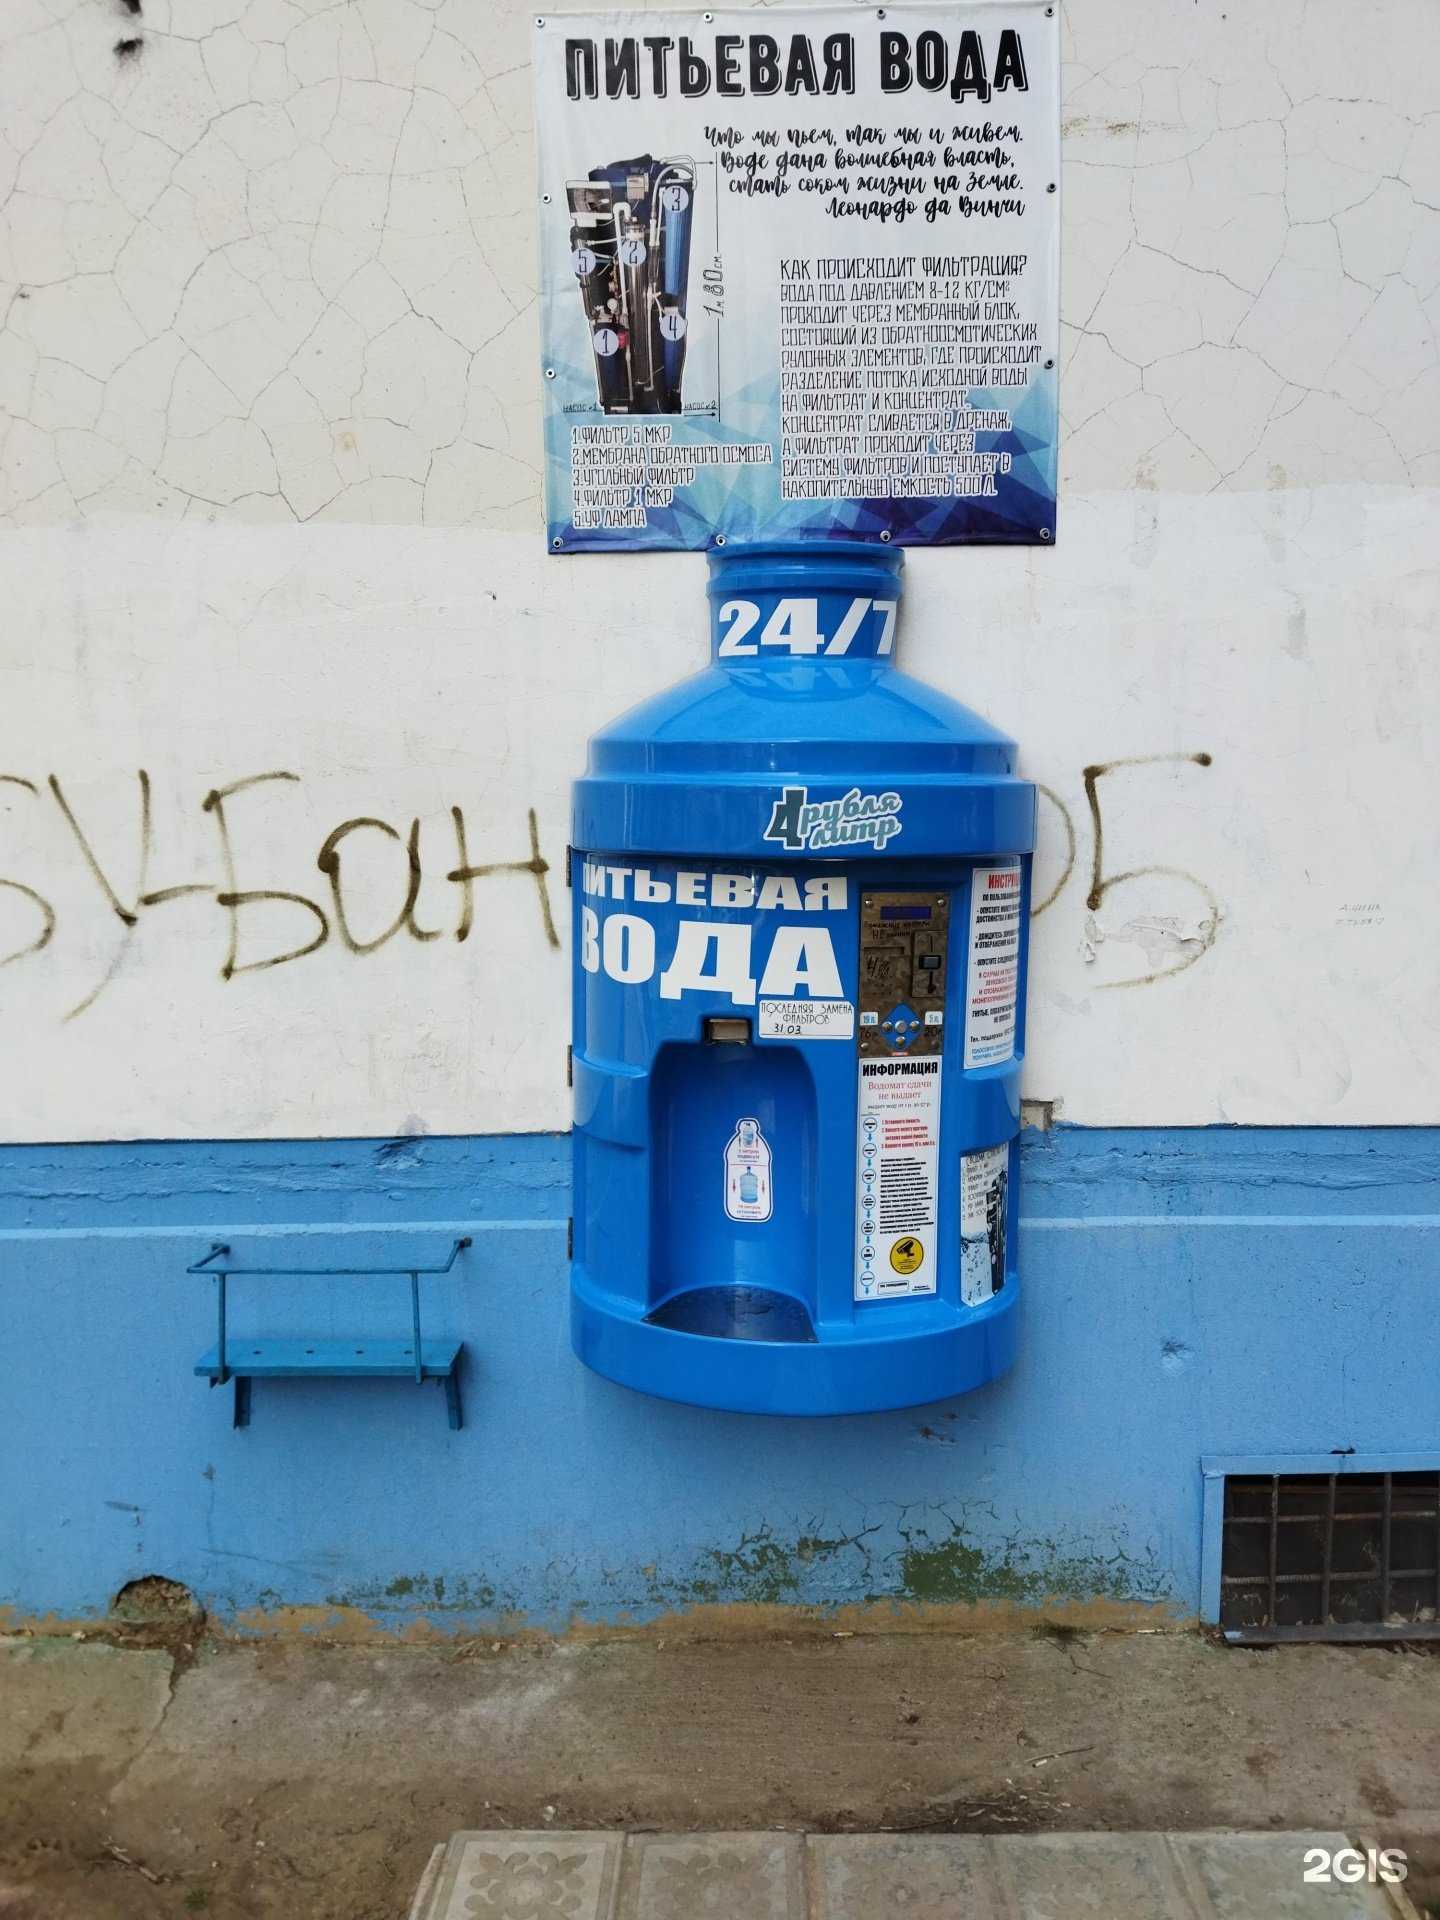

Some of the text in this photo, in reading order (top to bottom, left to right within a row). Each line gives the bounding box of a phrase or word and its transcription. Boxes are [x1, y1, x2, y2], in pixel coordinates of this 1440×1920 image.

[565, 29, 1029, 103] ПИТЬЕВАЯ ВОДА
[704, 125, 745, 148] Что
[752, 129, 780, 147] мы
[846, 125, 886, 145] так
[894, 127, 922, 145] мы
[929, 128, 944, 143] и
[952, 121, 1024, 143] живем.
[776, 151, 827, 176] дана
[834, 147, 937, 169] волшебная
[729, 175, 790, 197] стать
[798, 176, 850, 194] соком
[857, 174, 926, 197] жизни
[934, 174, 960, 193] на
[671, 187, 681, 212] 3
[924, 198, 951, 223] да
[578, 247, 587, 273] 5
[628, 240, 638, 265] 2
[781, 255, 1027, 280] КАК ПРОИСХОДИТ ФИЛЬТРАЦИЯ?
[781, 284, 814, 302] ВОДА
[819, 283, 846, 301] ПОД
[850, 281, 925, 302] ДАВЛЕНИЕМ
[930, 281, 959, 299] 8-12
[781, 300, 1020, 324] ПРОХОДИТ ЧЕРЕЗ МЕМБРАННЫЙ БЛОК,
[668, 317, 678, 339] 4
[781, 323, 1037, 346] СОСТОЯЩИЙ ИЗ ОБРАТНООСМОТИЧЕСКИХ
[602, 330, 609, 354] 1
[781, 345, 1042, 369] РУЛОННЫХ ЭЛЕМЕНТОВ, ГДЕ ПРОИСХОДИТ
[781, 366, 1028, 390] РАЗДЕЛЕНИЕ ПОТОКА ИСХОДНОЙ ВОДЫ
[782, 394, 800, 412] НА
[802, 392, 867, 411] ФИЛЬТРАТ
[871, 393, 880, 409] И
[633, 427, 641, 444] 5
[645, 425, 671, 444] МКР
[782, 415, 863, 434] КОНЦЕНТРАТ
[868, 413, 940, 432] СЛИВАЕТСЯ
[943, 413, 952, 430] В
[650, 446, 719, 464] ОБРАТНОГО
[722, 445, 772, 463] ОСМОСА
[782, 434, 974, 455] А ФИЛЬТРАТ ПРОХОДИТ ЧЕРЕЗ
[647, 467, 694, 485] ФИЛЬТР
[782, 455, 1010, 477] СИСТЕМУ ФИЛЬТРОВ И ПОСТУПАЕТ В
[635, 489, 641, 506] 1
[646, 488, 672, 506] МКР
[782, 478, 889, 498] НАКОПИТЕЛЬНУЮ
[893, 477, 952, 496] ЕМКОСТЬ
[955, 477, 980, 495] 500
[604, 508, 646, 527] ЛАМПА
[719, 598, 897, 657] 24/7
[766, 789, 901, 848] 4 рубля
[811, 817, 901, 848] литр
[582, 905, 844, 1005] ВОДА
[761, 1003, 852, 1016] ПОСЛЕДНЯЯ ЗАМЕНА
[783, 1014, 830, 1024] ФИЛЬТРОВ
[862, 1062, 938, 1077] ИНФОРМАЦИЯ
